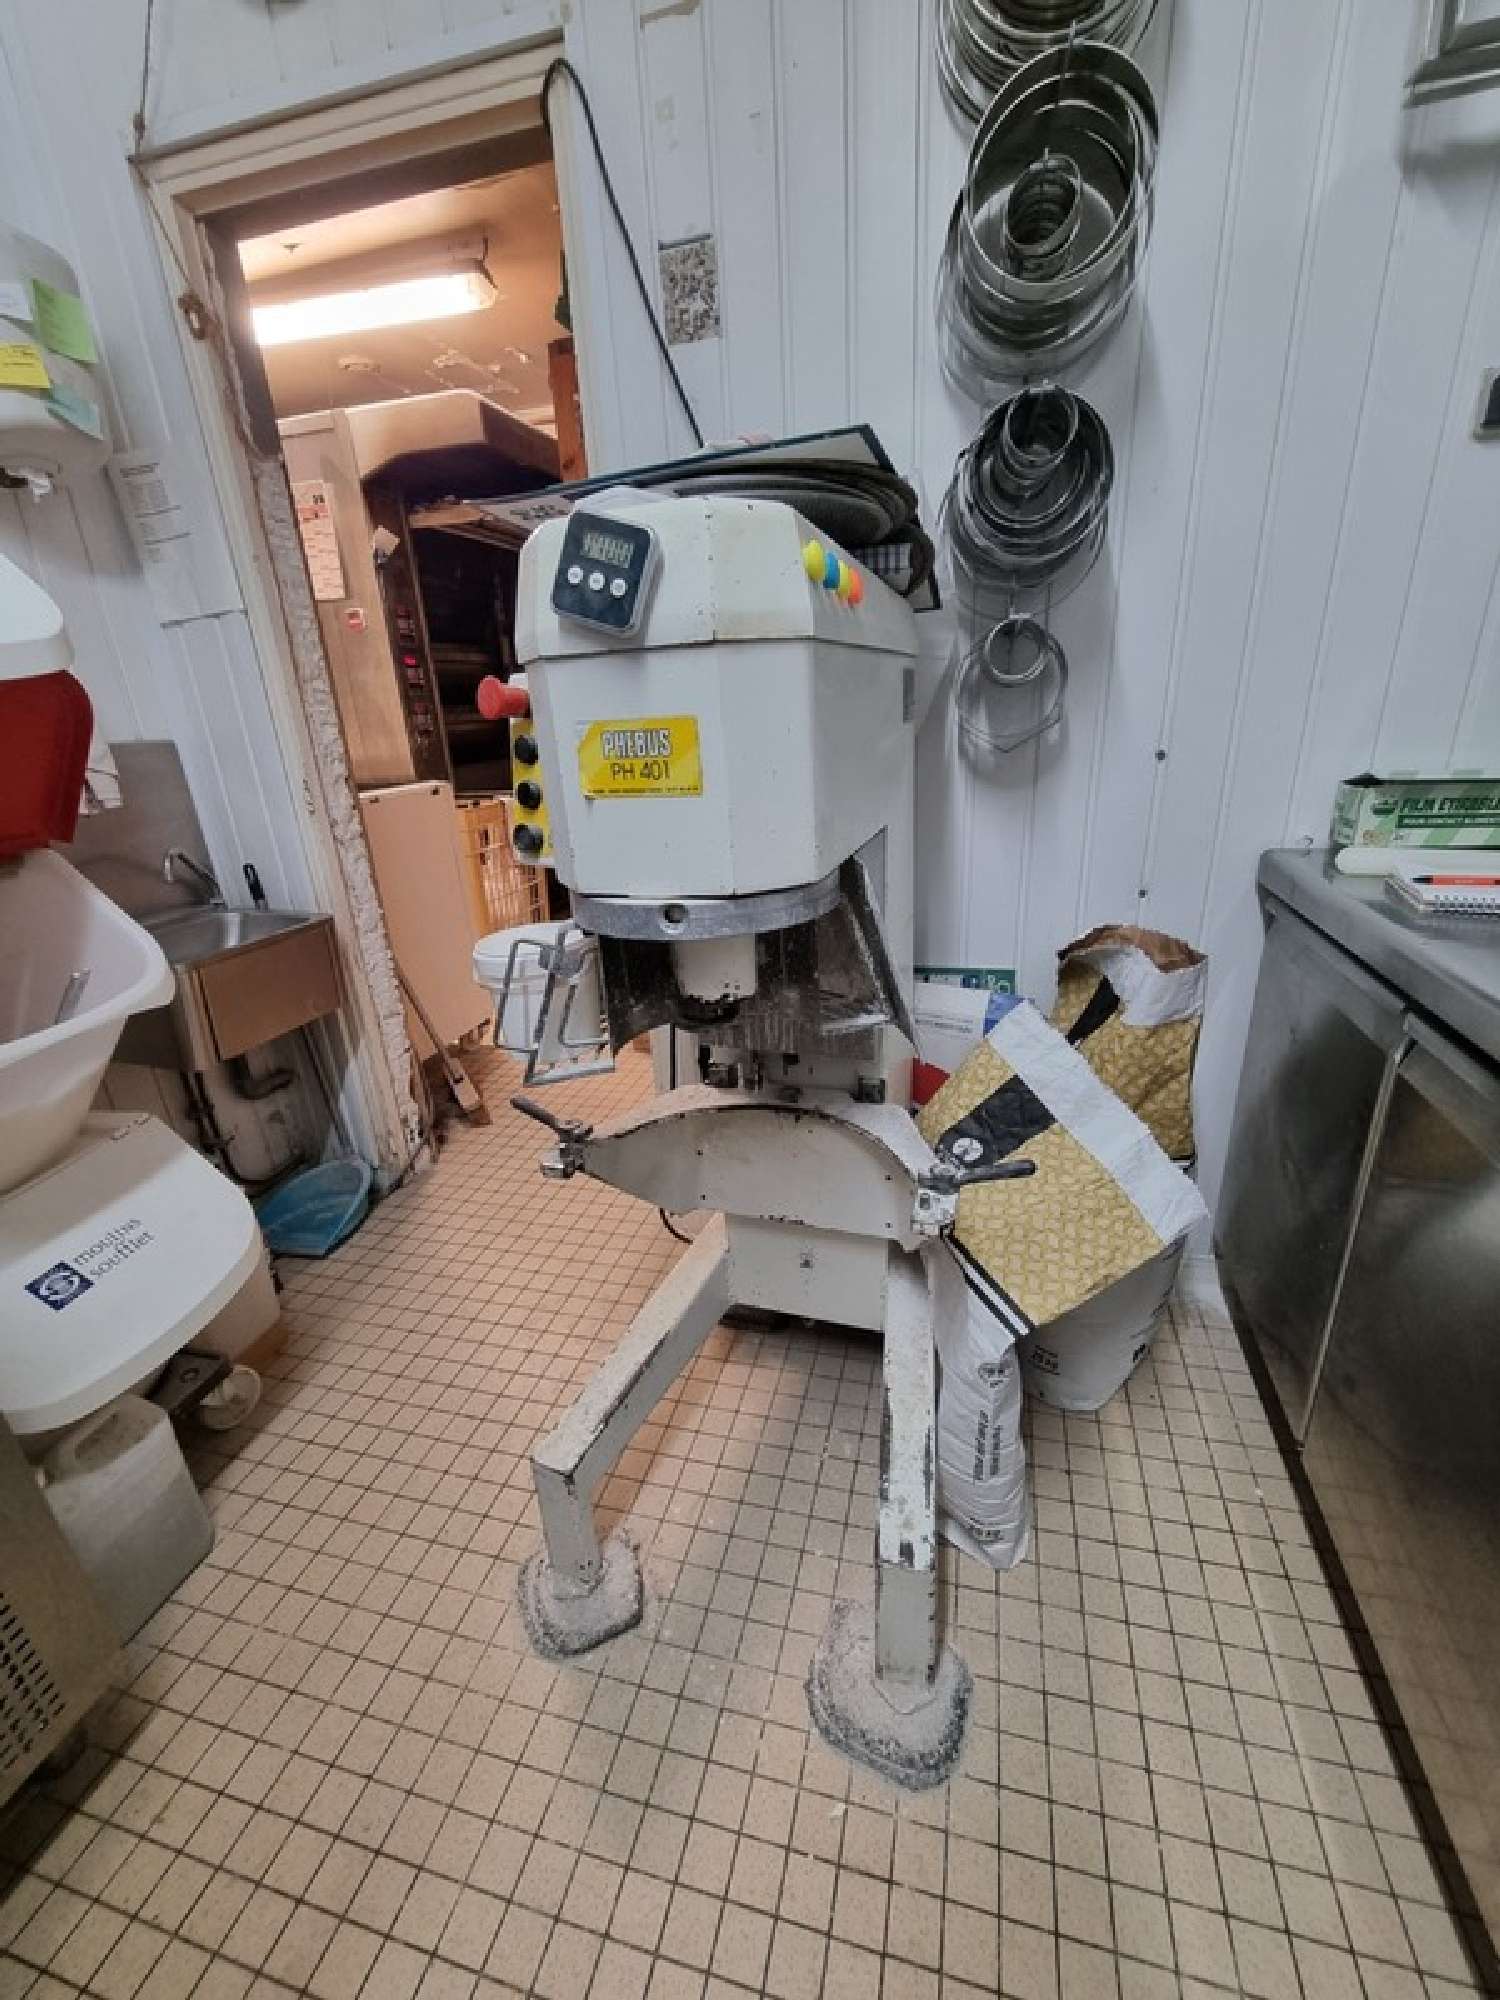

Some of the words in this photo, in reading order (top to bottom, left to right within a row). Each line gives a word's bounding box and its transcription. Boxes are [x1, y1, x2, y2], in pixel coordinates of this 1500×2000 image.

[602, 728, 671, 760] PHEBUS
[610, 762, 635, 780] PH
[639, 759, 670, 780] 401
